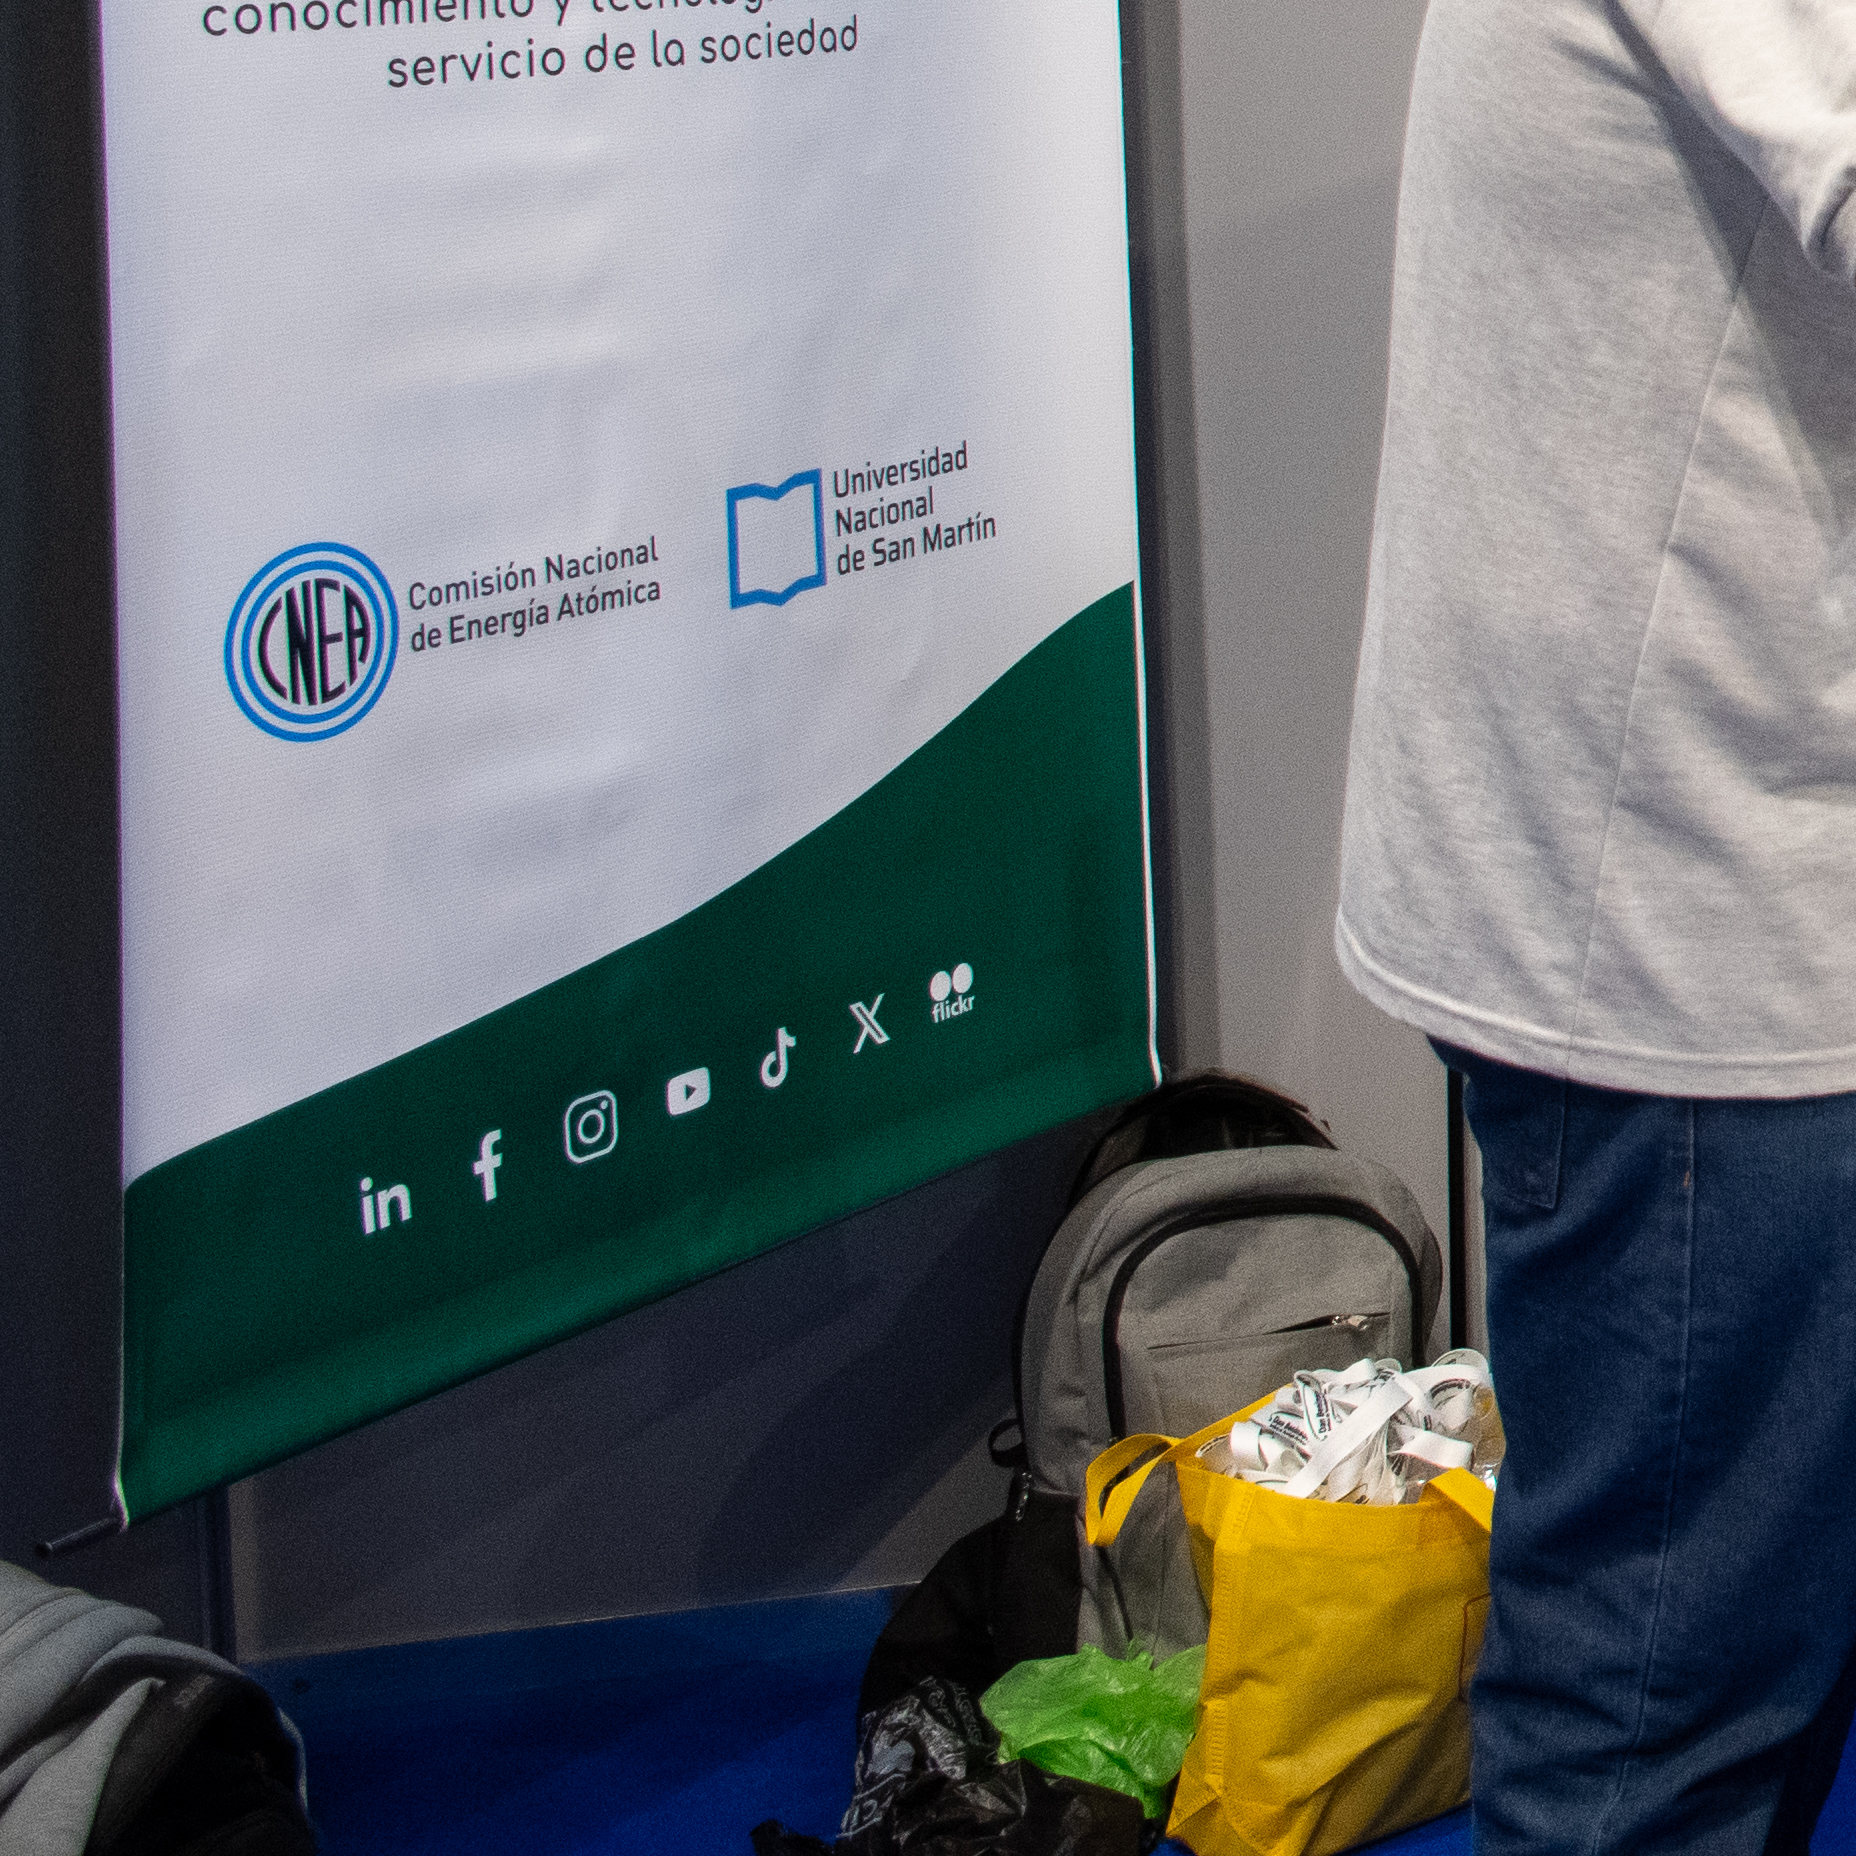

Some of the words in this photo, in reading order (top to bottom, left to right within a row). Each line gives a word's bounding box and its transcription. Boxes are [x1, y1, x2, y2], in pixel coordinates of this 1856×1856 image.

[386, 34, 567, 89] servicio
[584, 30, 637, 72] de
[651, 27, 687, 68] la
[699, 14, 860, 65] sociedad
[832, 440, 969, 501] Universidad
[835, 486, 934, 538] Nacional
[836, 543, 868, 578] de
[870, 526, 917, 568] San
[922, 510, 997, 557] Martín
[408, 560, 538, 612] Comisión
[545, 535, 660, 581] Nacional
[257, 576, 372, 708] CNEA
[410, 620, 444, 654] de
[449, 596, 551, 646] Energía
[556, 575, 662, 622] Atómica
[930, 993, 977, 1024] flickr
